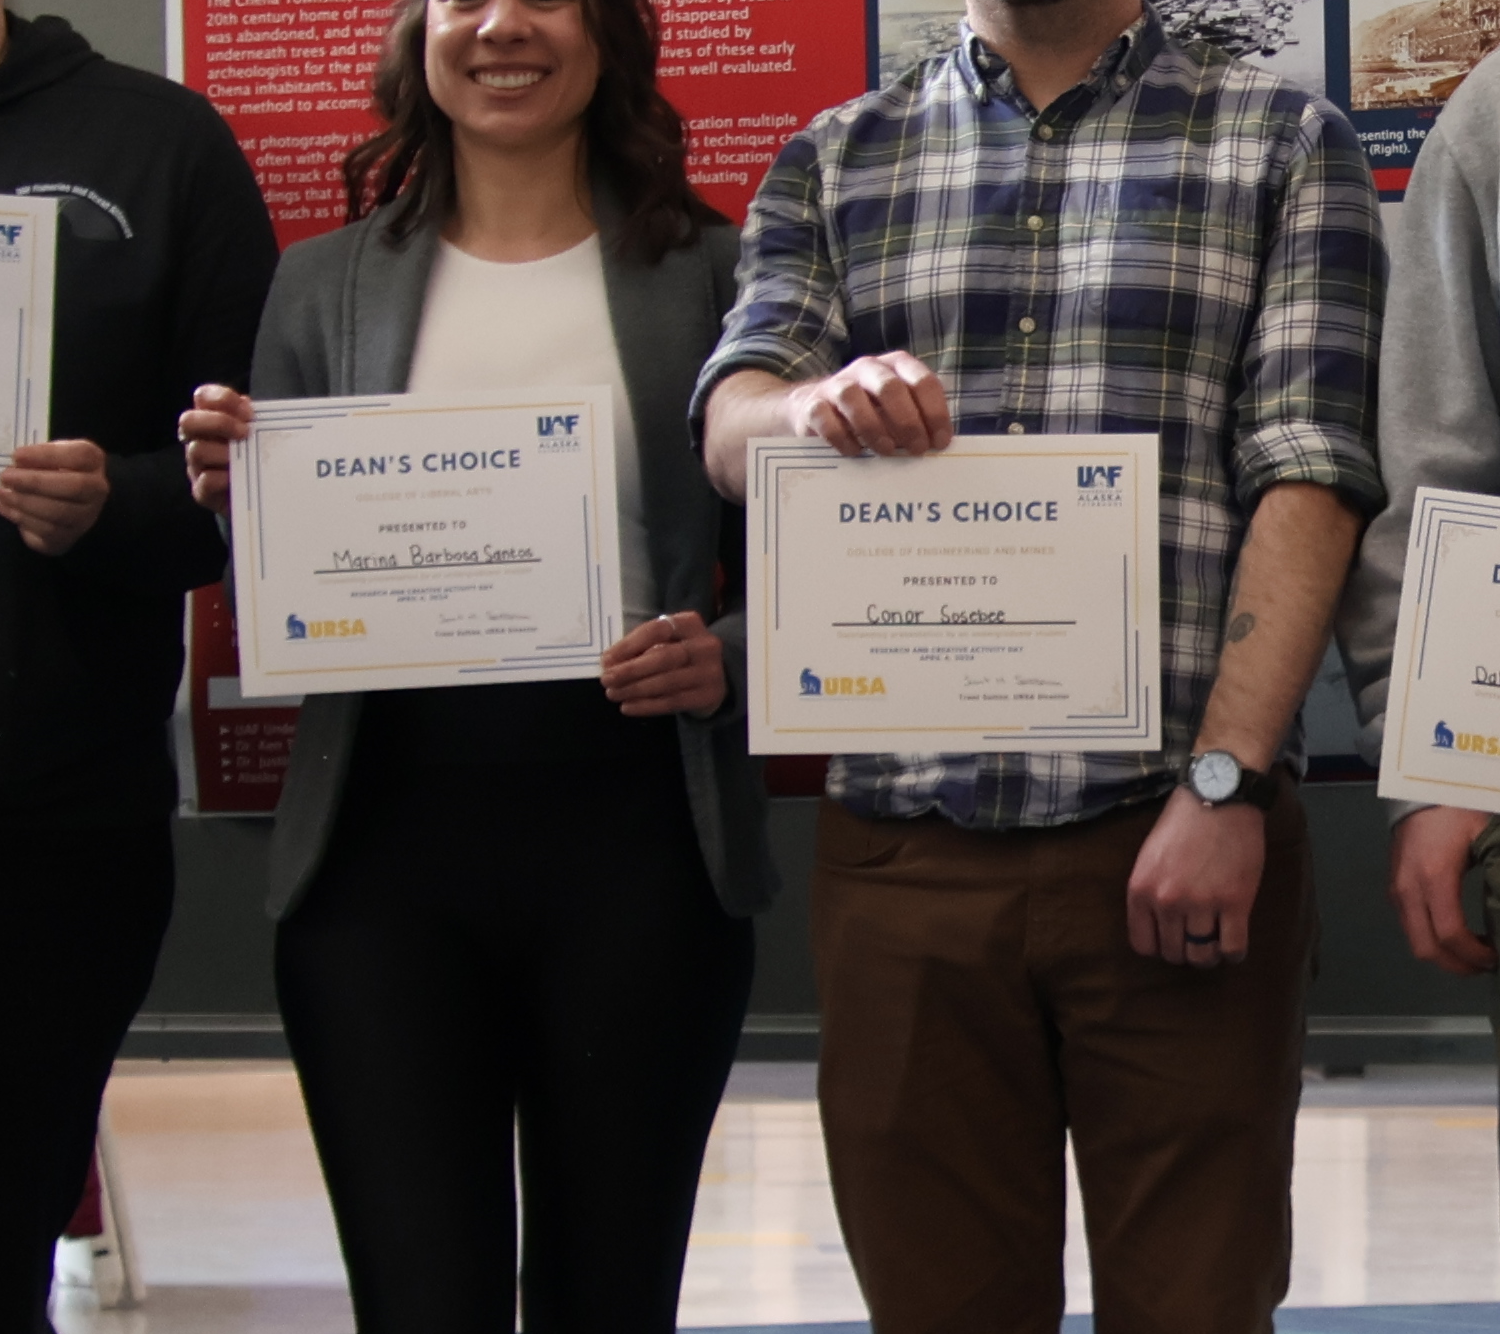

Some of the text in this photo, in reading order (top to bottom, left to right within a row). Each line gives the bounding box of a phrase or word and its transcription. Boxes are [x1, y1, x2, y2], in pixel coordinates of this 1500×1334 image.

[317, 450, 520, 478] DEAN'S CHOICE
[1078, 466, 1122, 488] UAF
[840, 501, 1057, 523] DEAN'S CHOICE
[333, 545, 534, 570] Marina Barbosa Santos
[903, 576, 997, 586] PRESENTED TO
[867, 604, 1005, 624] Conor Sosebee
[824, 677, 886, 695] URSA
